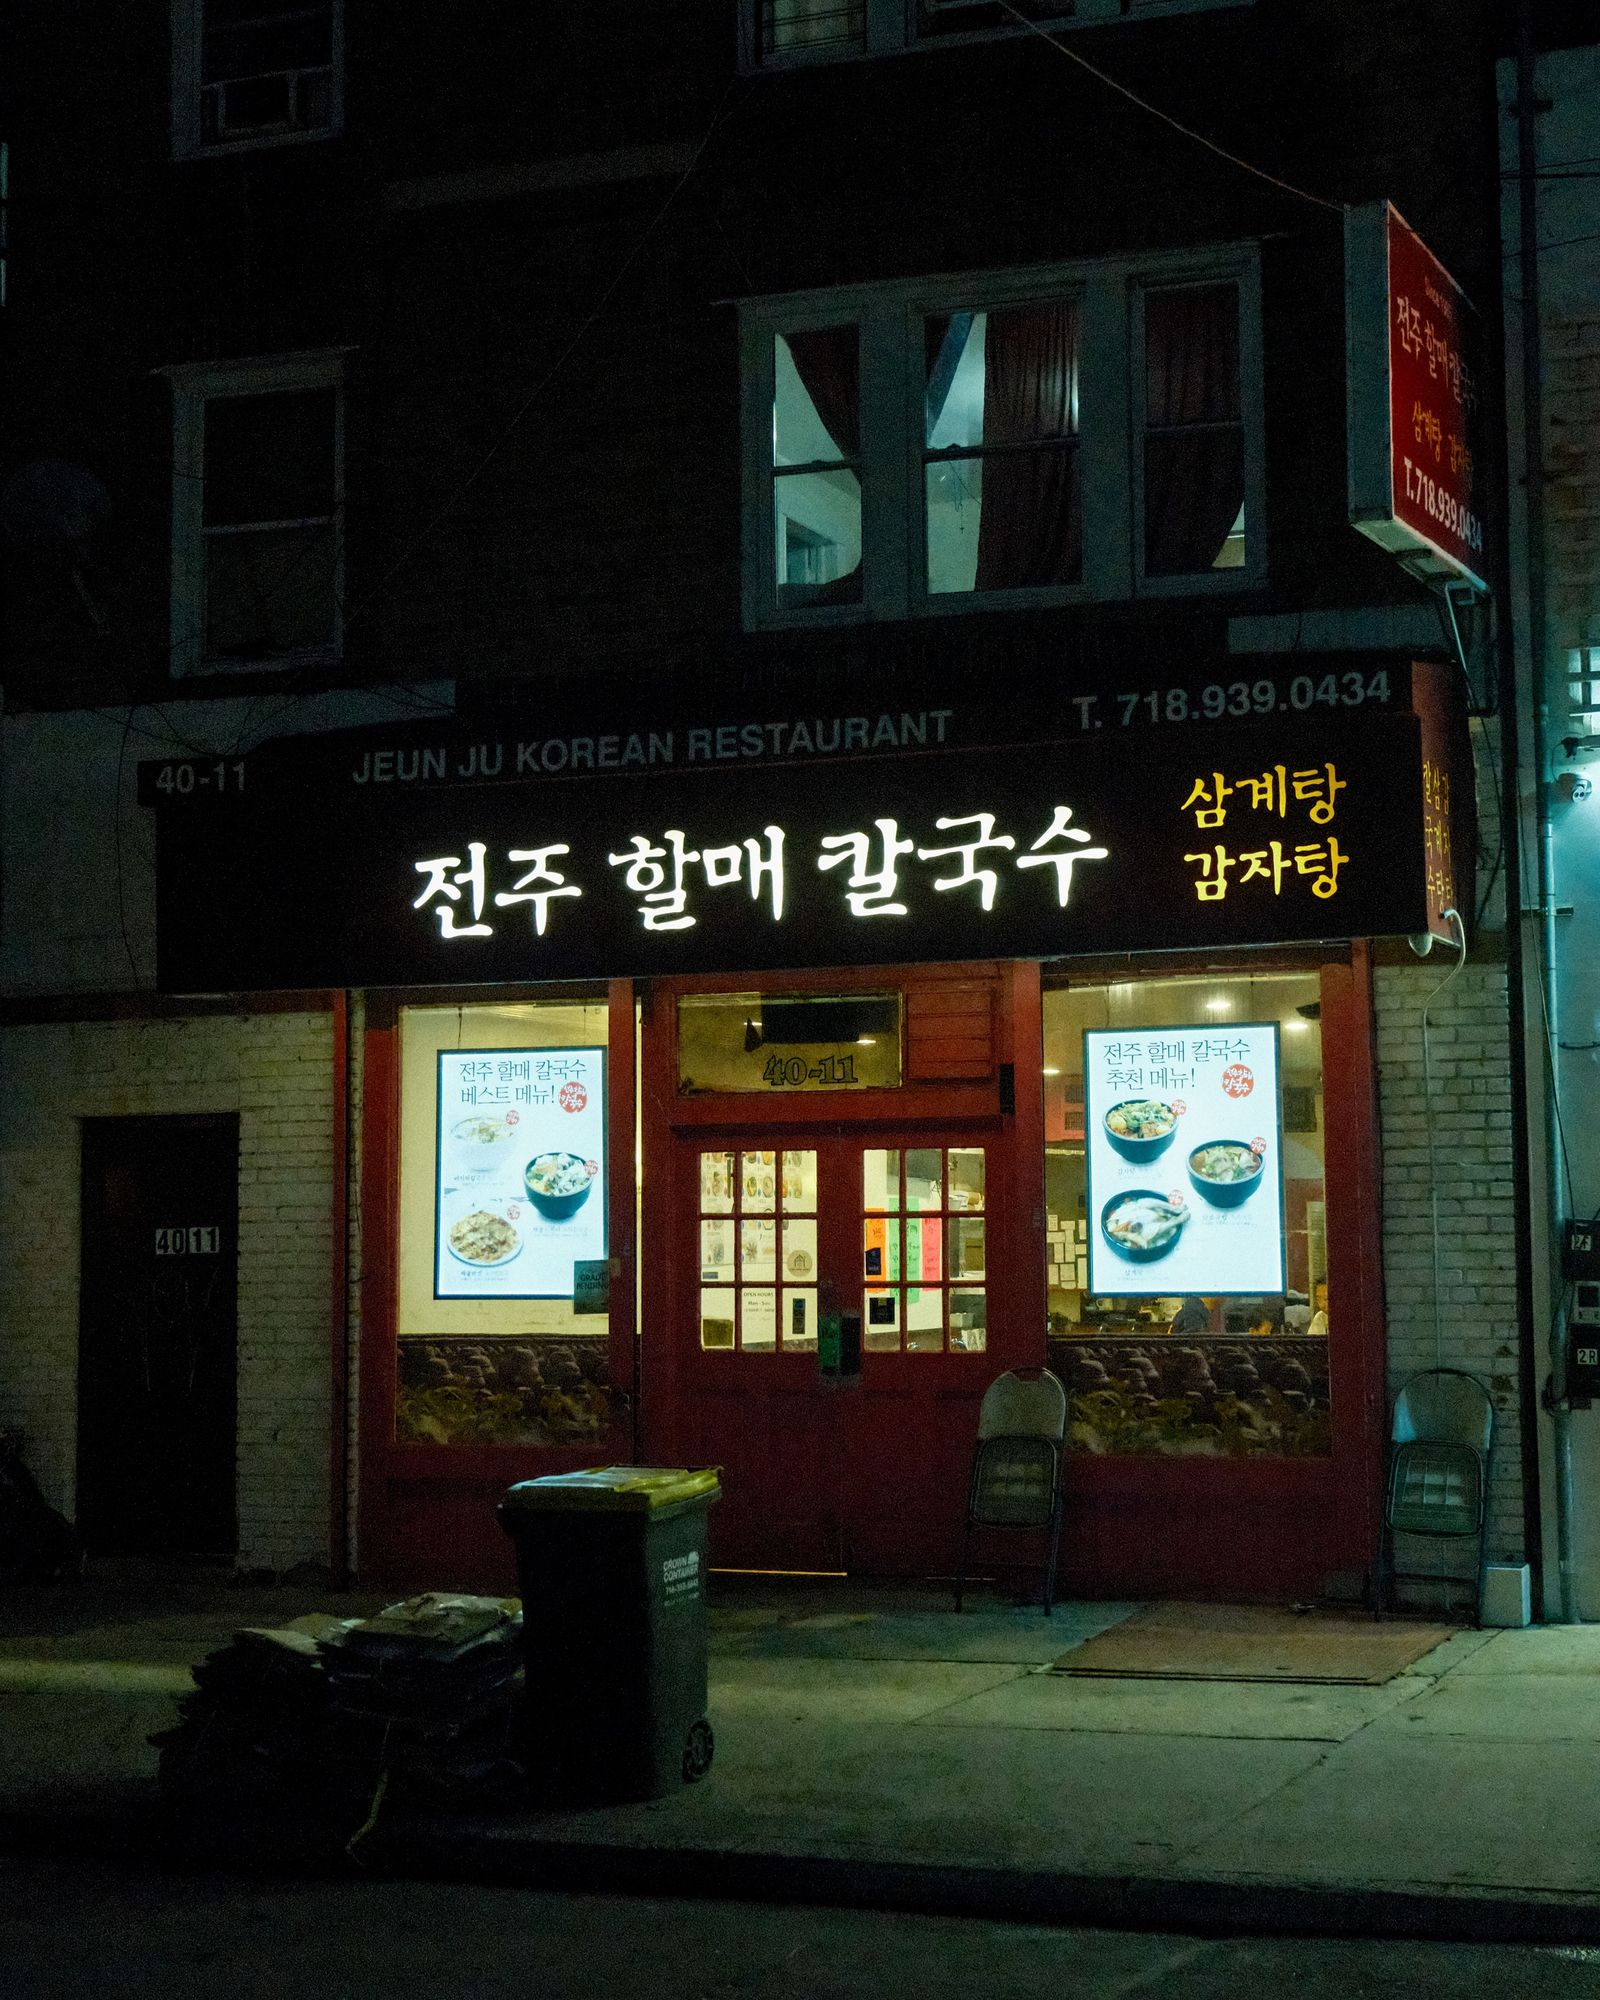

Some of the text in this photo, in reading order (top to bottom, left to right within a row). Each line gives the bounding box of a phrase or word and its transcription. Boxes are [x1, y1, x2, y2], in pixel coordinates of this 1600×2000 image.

[1397, 296, 1424, 360] 전주
[1424, 320, 1449, 389] 할매
[1412, 400, 1443, 463] 삼계탕
[1073, 670, 1391, 730] T. 718.939.0434
[352, 709, 953, 784] JEUN JU KOREAN RESTAURANT
[156, 761, 245, 794] 40-11
[1181, 762, 1347, 829] 삼계탕
[412, 805, 1110, 939] 전주 할매 칼국수
[1184, 836, 1350, 901] 감자탕
[459, 1058, 588, 1083] 전주 할매 칼국수
[762, 1055, 858, 1086] 40-11
[1103, 1038, 1251, 1065] 전주 할매 칼국수
[1106, 1067, 1196, 1091] 추천 메뉴!
[461, 1084, 555, 1106] 베스트 메뉴!
